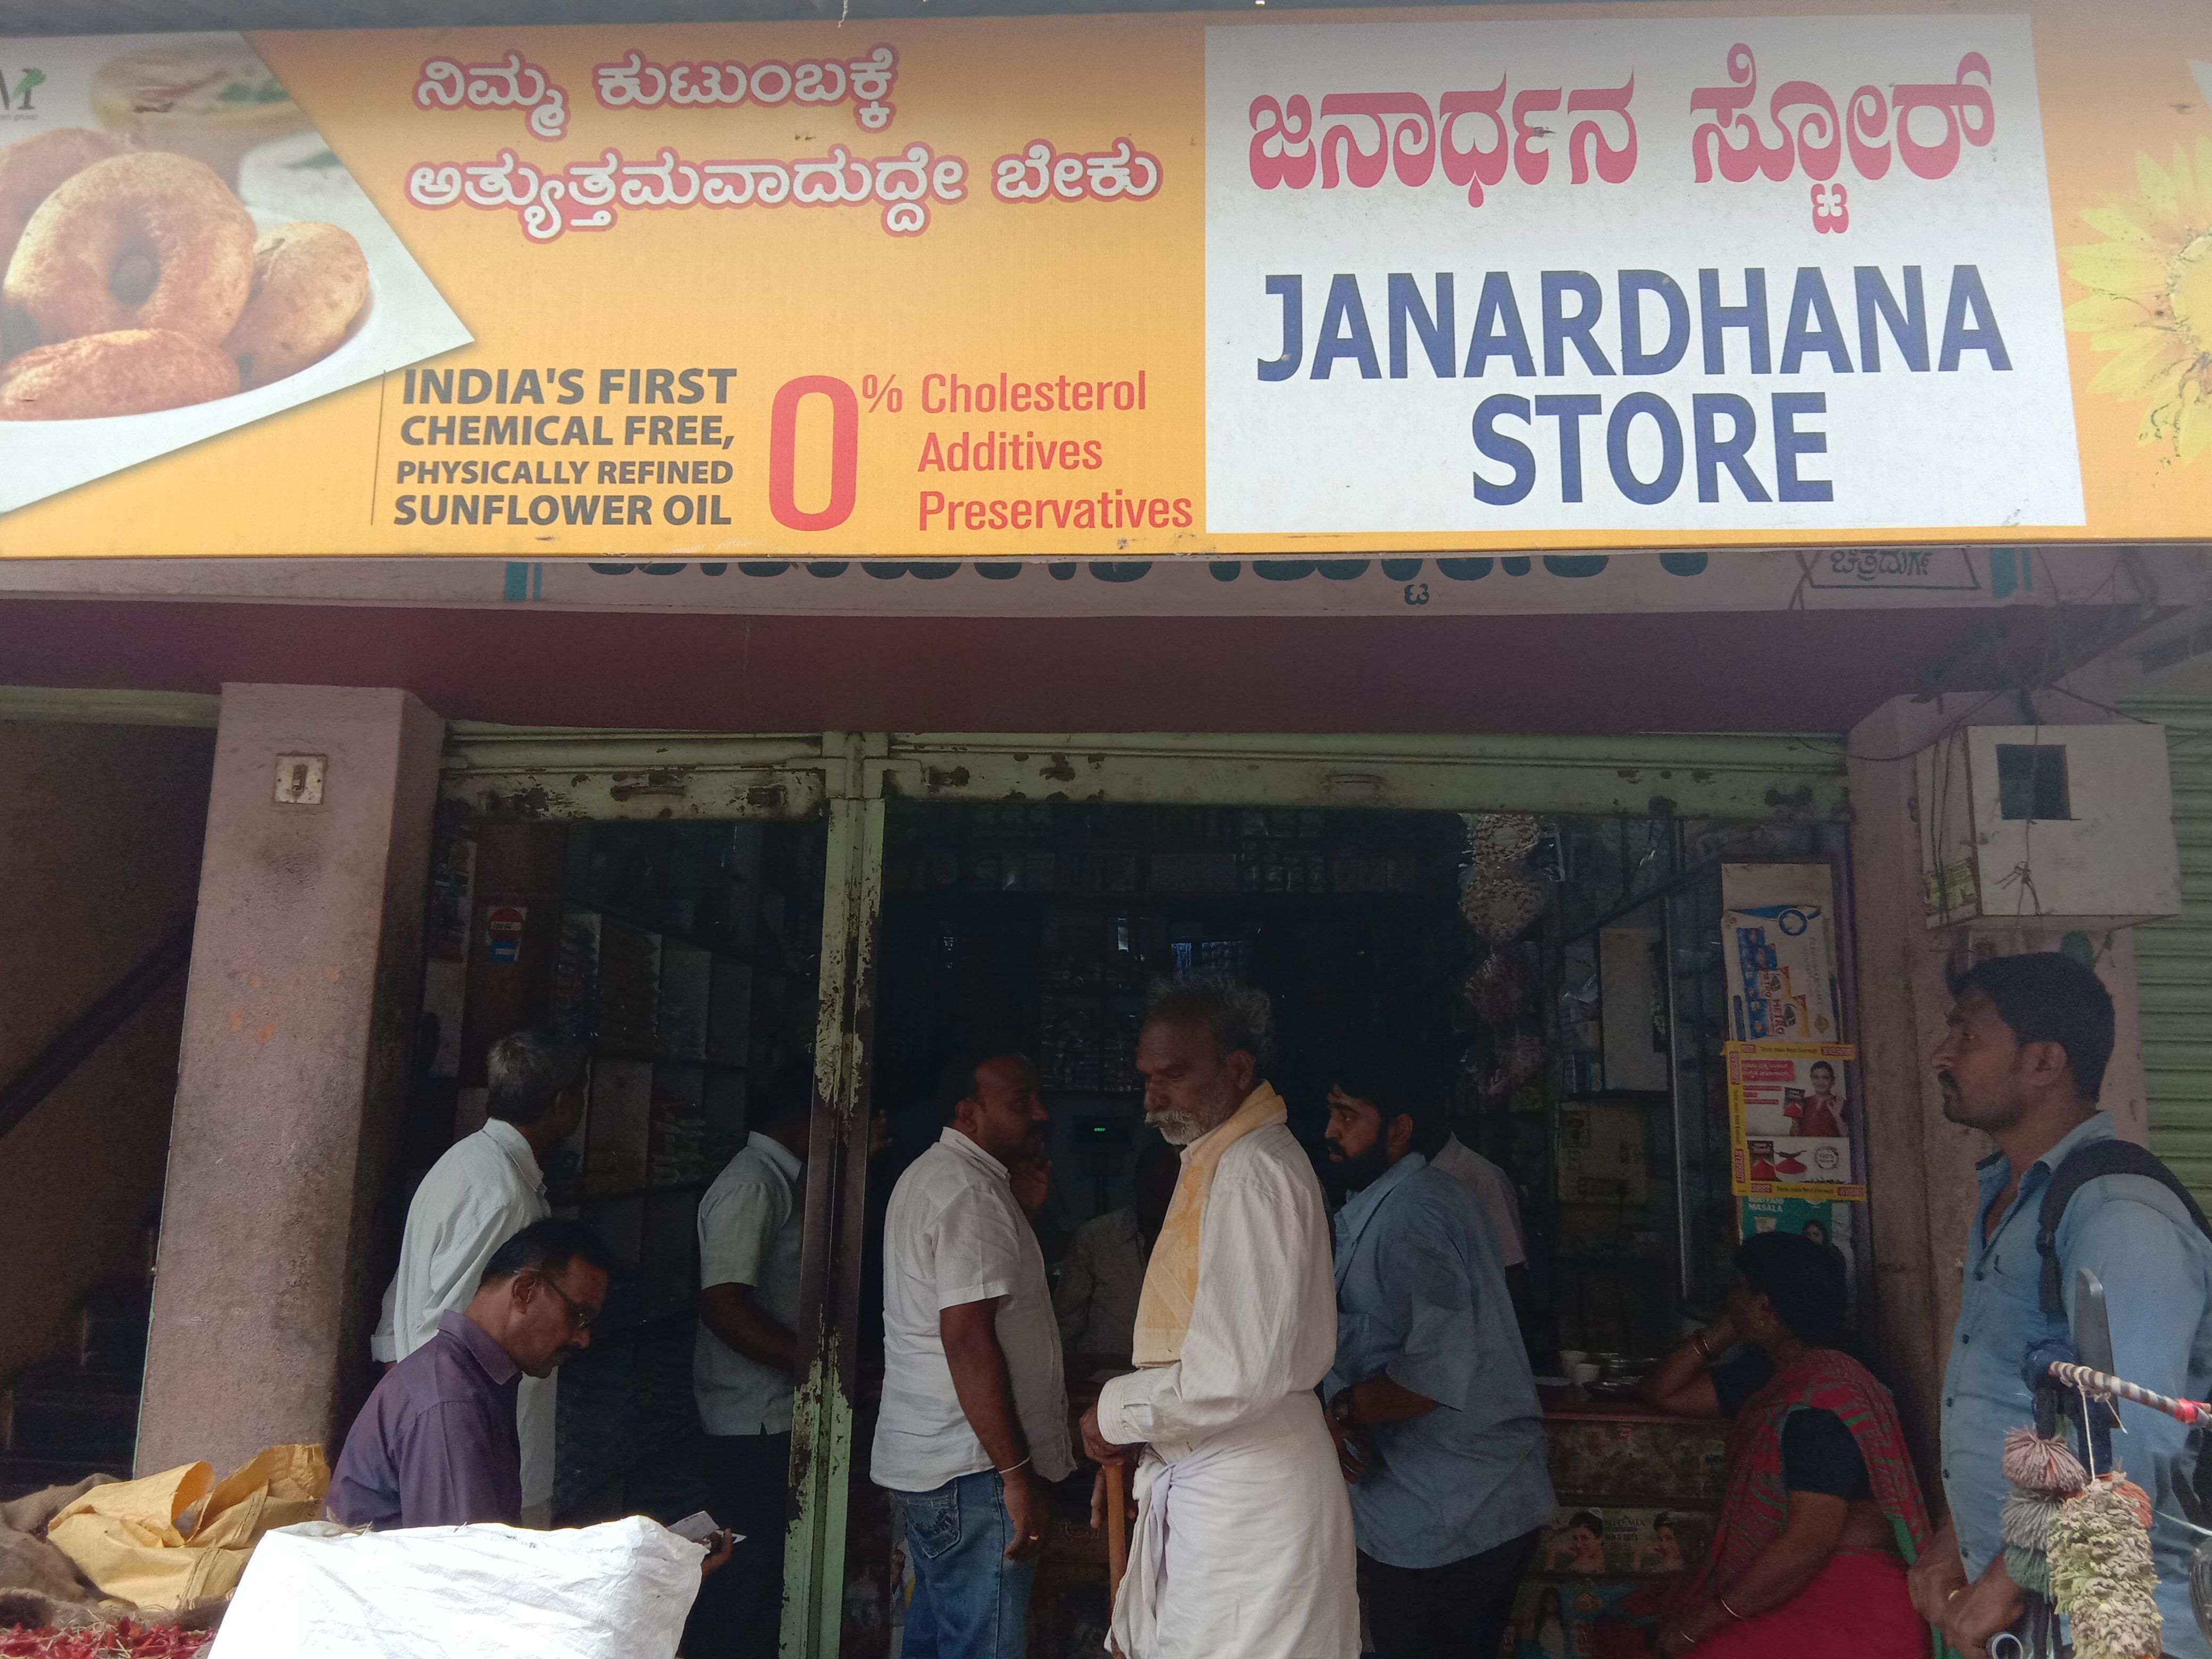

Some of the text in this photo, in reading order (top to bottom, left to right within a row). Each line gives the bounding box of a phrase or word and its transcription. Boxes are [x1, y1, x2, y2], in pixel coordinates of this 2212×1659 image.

[417, 46, 894, 137] ನಿಮ್ಮ ಕುಟುಂಬಕ್ಕೆ
[1249, 68, 1638, 207] ಜನಾರ್ಧನ
[996, 142, 1159, 198] ಬೇಕು
[1258, 265, 2011, 382] JANARDHANA
[404, 368, 738, 405] INDIA'S FIRST
[922, 371, 1146, 413] Cholesterol
[400, 415, 735, 450] CHEMICAL FREE,
[918, 431, 1103, 472] Additives
[1470, 391, 1833, 506] STORE
[397, 460, 734, 484] PHYSICALLY REFINED
[393, 495, 732, 525] SUNFLOWER OIL
[918, 489, 1193, 531] Preservatives
